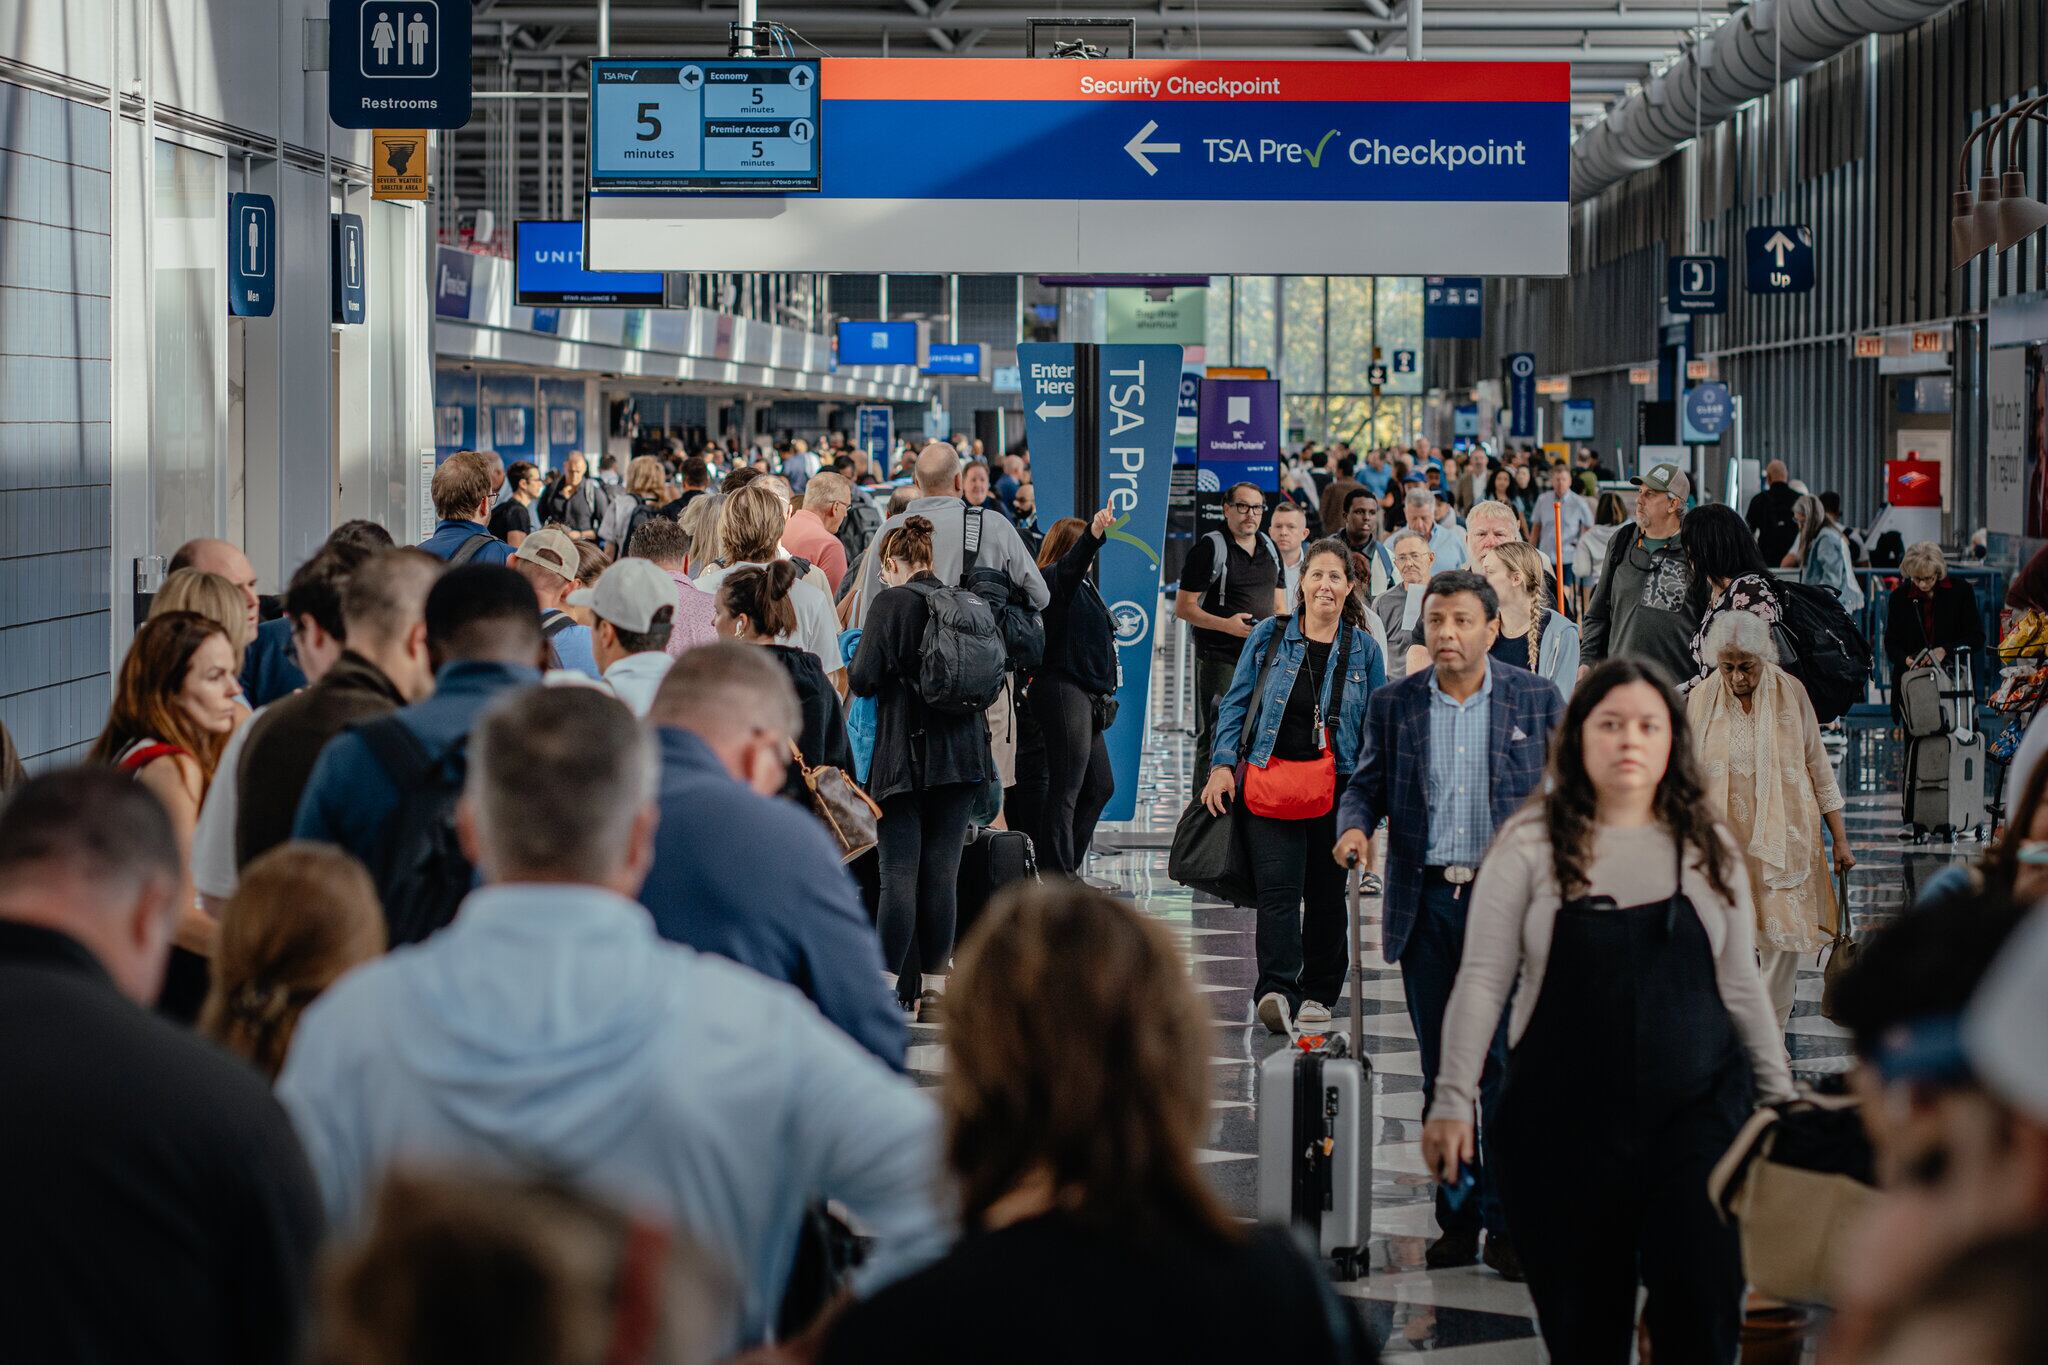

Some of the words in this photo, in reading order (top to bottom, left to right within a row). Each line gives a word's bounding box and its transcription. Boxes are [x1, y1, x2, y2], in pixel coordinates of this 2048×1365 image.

[710, 72, 748, 82] Economy
[1079, 76, 1162, 98] Security
[1166, 76, 1281, 98] Checkpoint
[361, 98, 438, 109] Restrooms
[751, 87, 763, 105] 5
[740, 105, 775, 113] minutes
[636, 102, 662, 142] 5
[710, 125, 744, 133] Premier
[624, 149, 675, 158] minutes
[751, 140, 763, 159] 5
[1203, 138, 1253, 164] TSA
[1259, 138, 1302, 164] Pre
[1348, 138, 1526, 171] Checkpoint
[740, 158, 775, 167] minutes
[1770, 272, 1791, 288] Up
[247, 289, 260, 302] Men
[1858, 336, 1882, 354] EXIT
[1913, 332, 1938, 352] EXIT
[1031, 363, 1075, 379] Enter
[1036, 379, 1075, 395] Here
[1109, 359, 1145, 437] TSA
[1210, 440, 1237, 450] United
[1109, 447, 1145, 512] Pre
